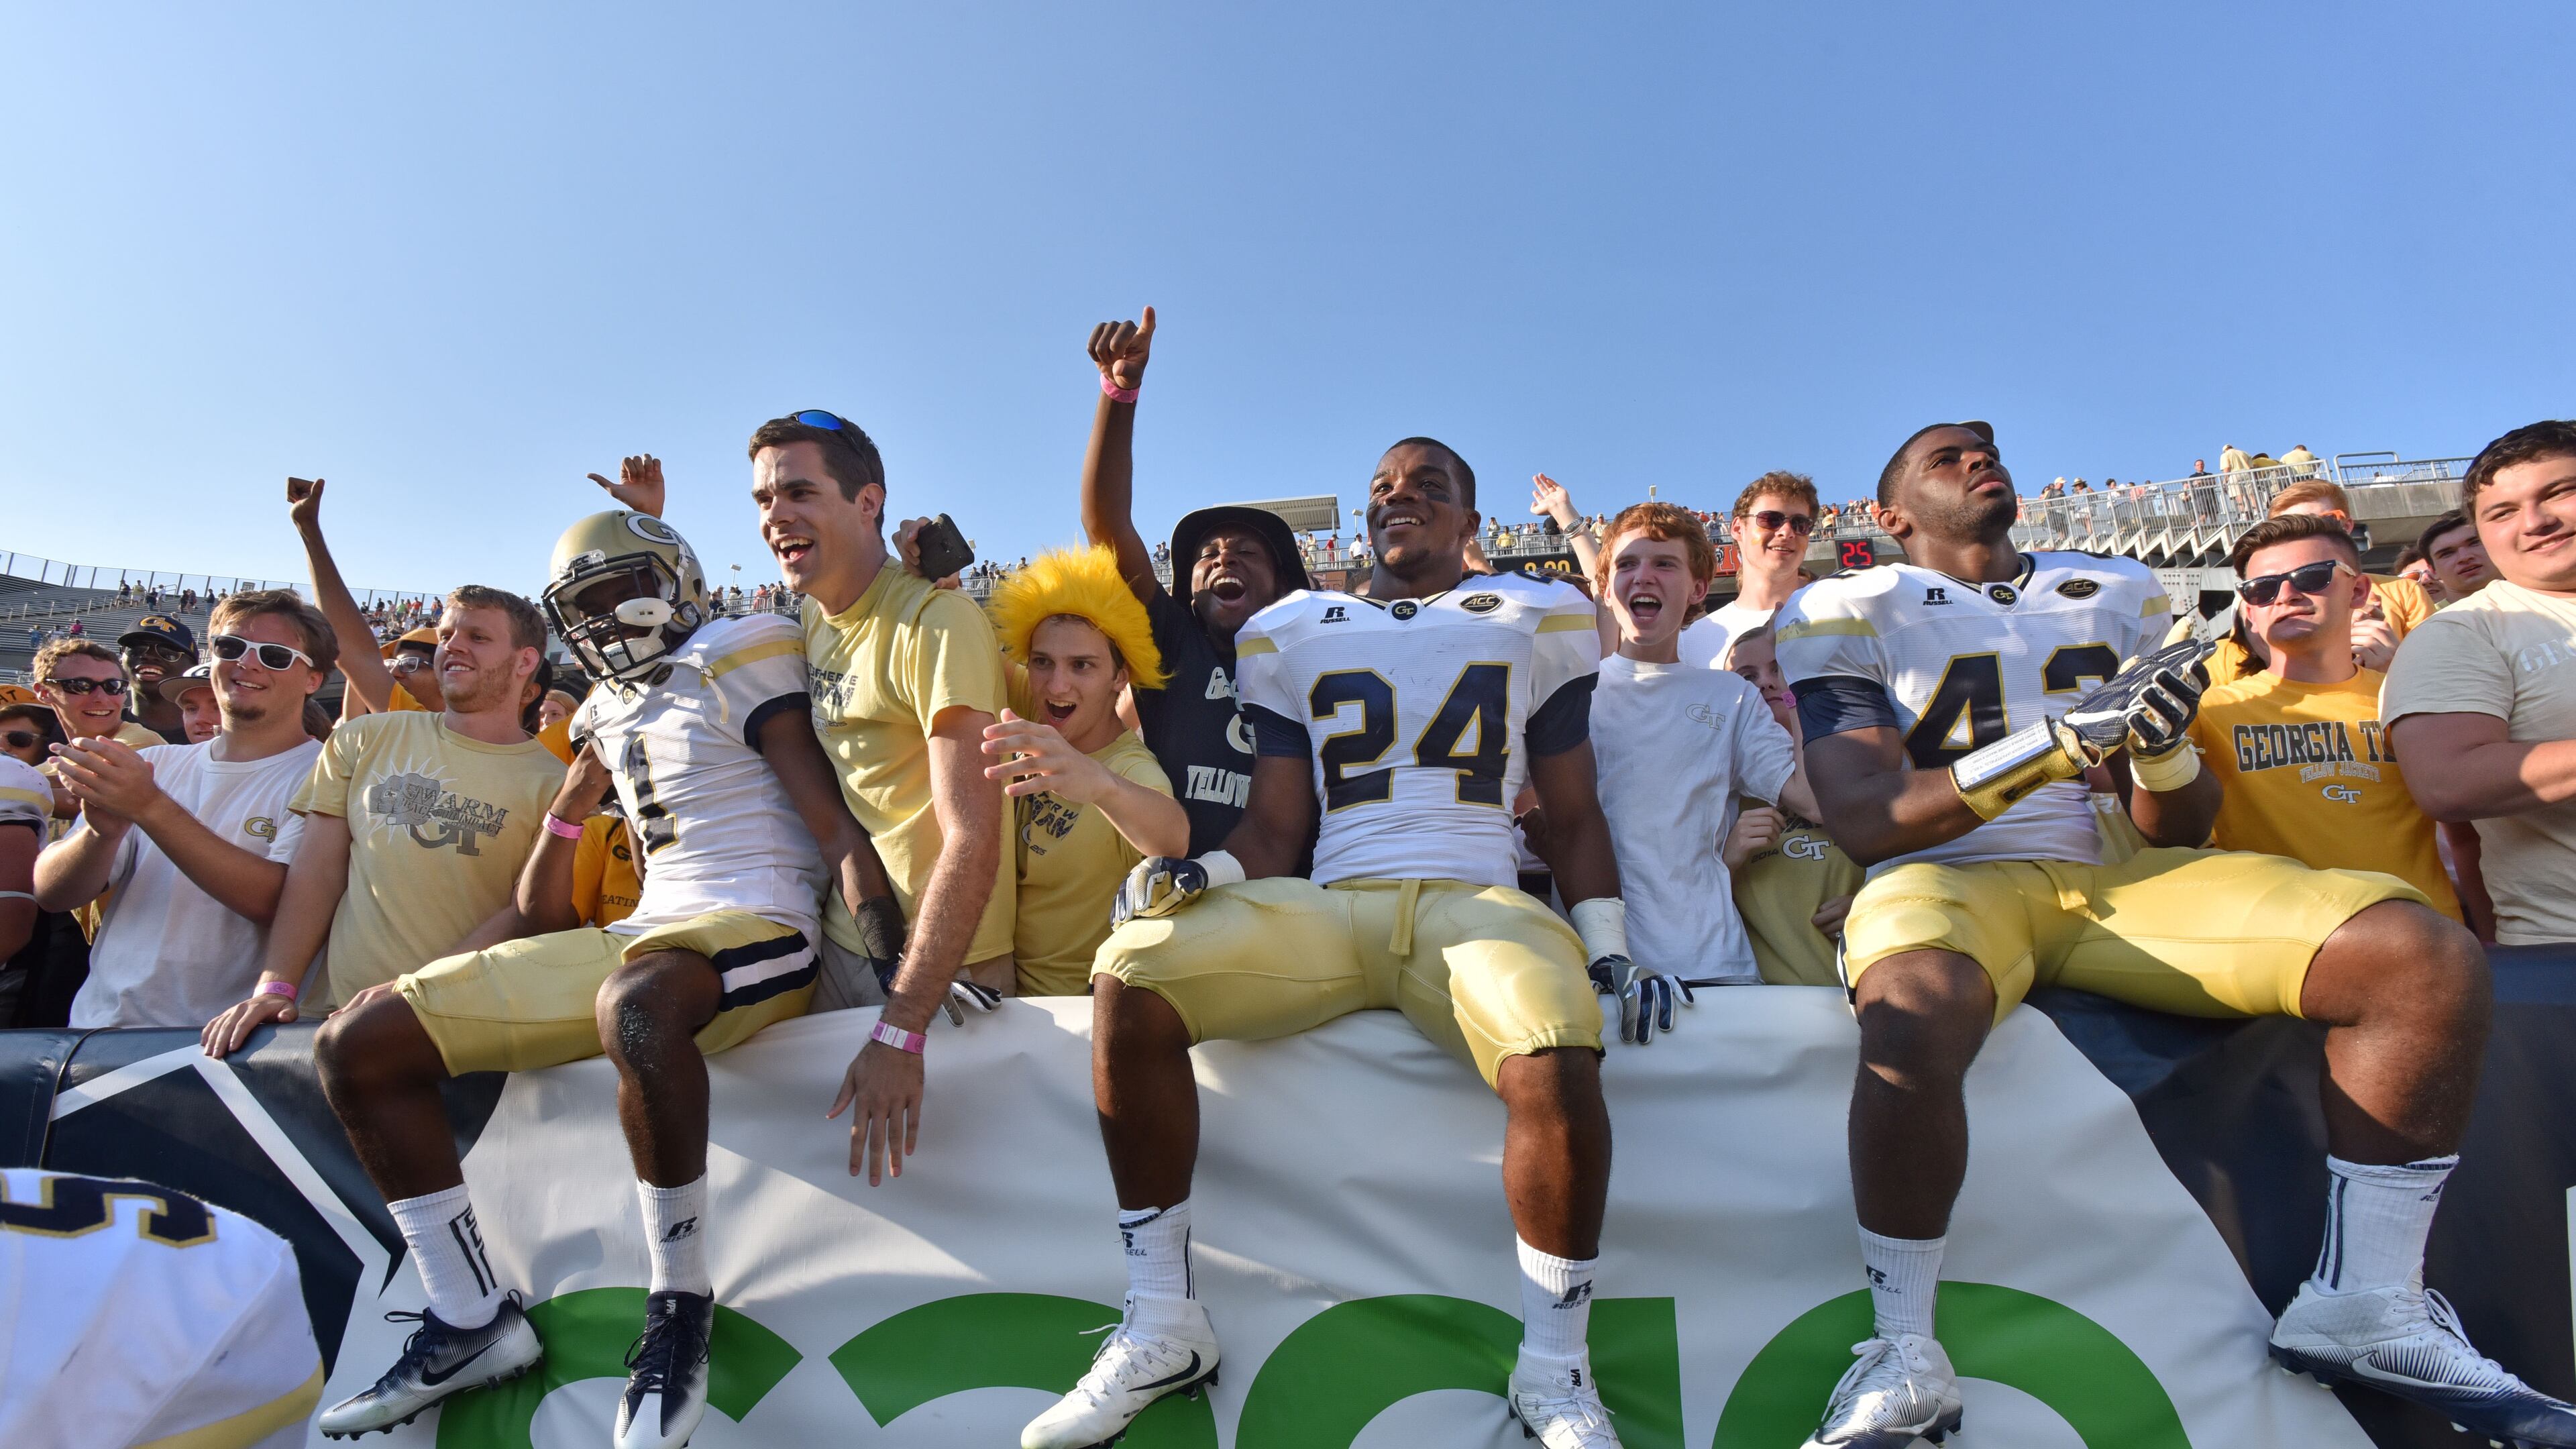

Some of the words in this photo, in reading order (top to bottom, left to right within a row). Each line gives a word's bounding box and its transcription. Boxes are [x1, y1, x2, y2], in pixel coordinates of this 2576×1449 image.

[1843, 541, 1872, 567] 25
[1993, 589, 2015, 600] GT
[2063, 581, 2094, 592] ACC
[1395, 605, 1414, 616] GT
[1465, 596, 1496, 606] ACC
[140, 615, 177, 633] GT
[1685, 703, 1725, 731] GT
[1308, 661, 1512, 815] 24
[2233, 721, 2356, 773] GEORGIA
[2300, 762, 2335, 784] YELLOW
[2339, 761, 2381, 783] JACKETS
[625, 733, 679, 857] 1
[1185, 765, 1252, 809] YELLOW
[2321, 784, 2363, 804] GT
[405, 783, 510, 826] SWARM
[1751, 849, 1780, 864] 2014
[1782, 835, 1830, 861] GT
[1570, 1368, 1582, 1387] VPR
